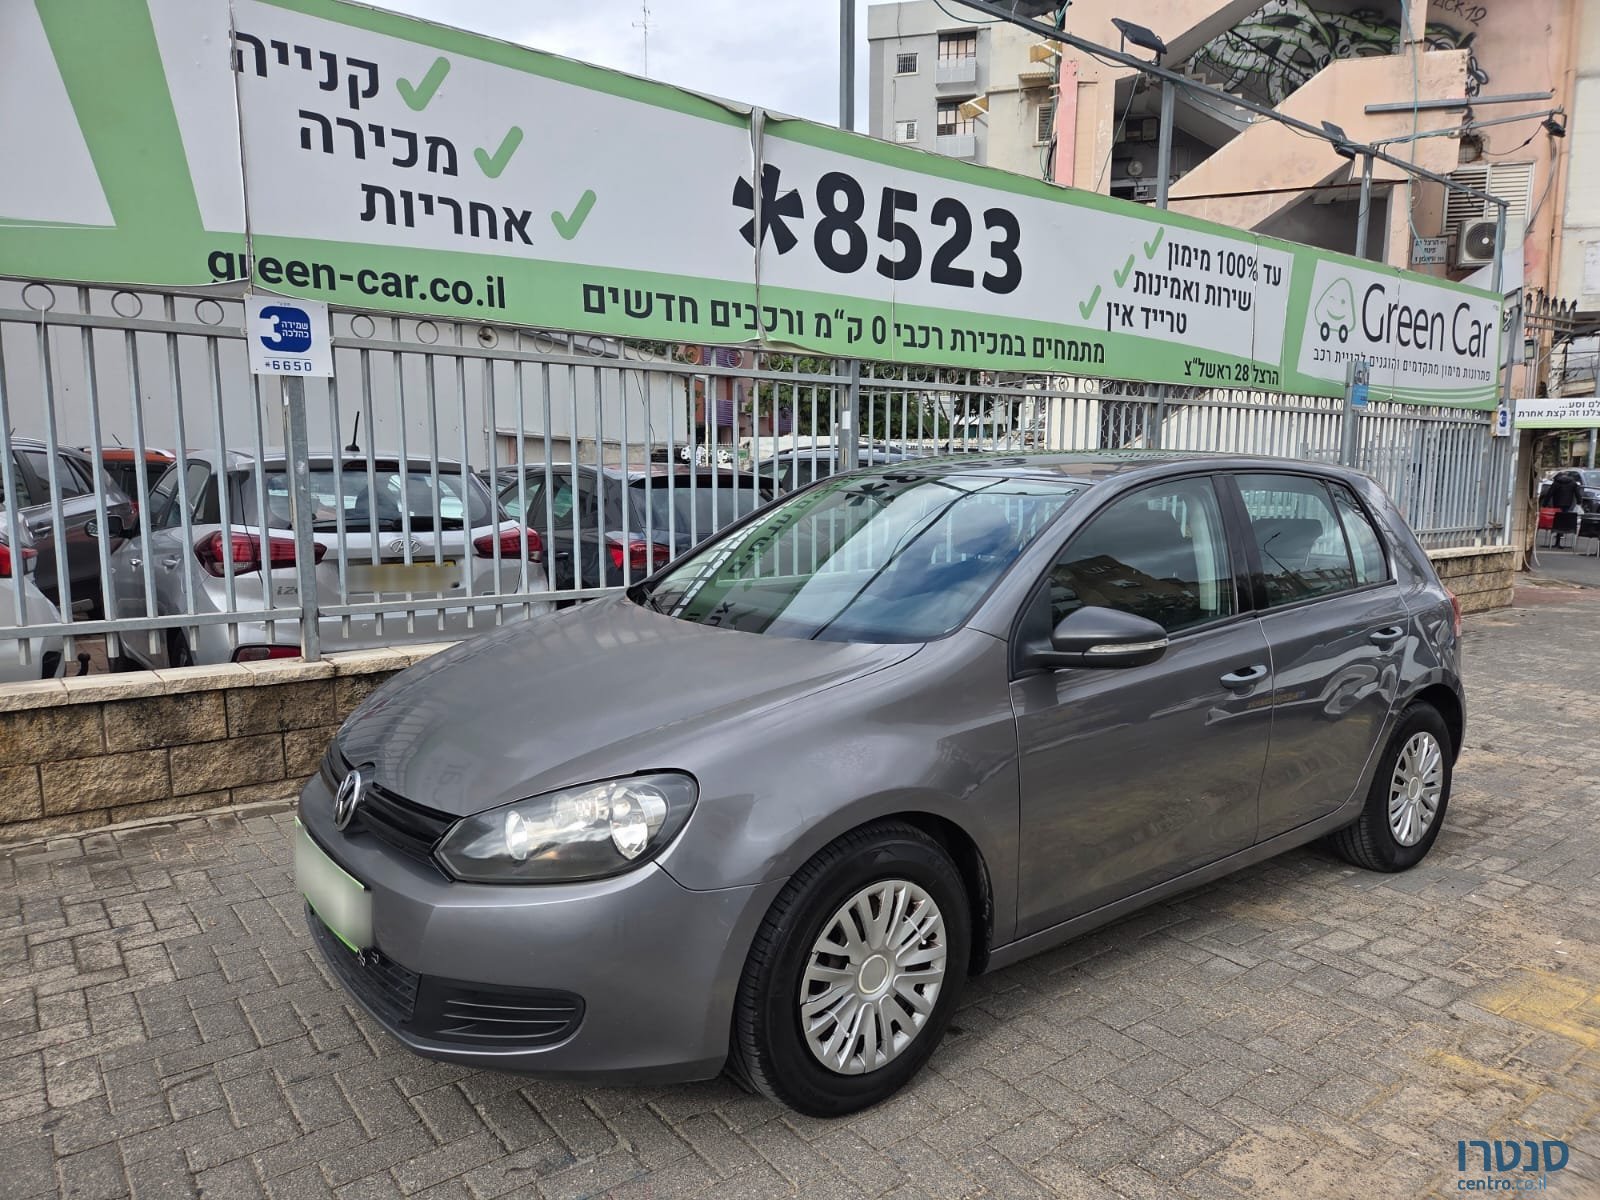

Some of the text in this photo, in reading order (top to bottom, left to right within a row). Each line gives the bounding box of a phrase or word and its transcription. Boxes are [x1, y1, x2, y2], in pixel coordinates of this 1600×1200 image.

[234, 31, 380, 110] קנייה
[299, 109, 458, 176] מכירה
[360, 183, 534, 245] אחריות
[1168, 242, 1282, 286] עד 100% מימון
[207, 249, 505, 309] green-car.co.il
[1133, 270, 1252, 312] שירות ואמינות
[582, 283, 698, 324] חדשים
[281, 321, 309, 330] שמירה
[710, 300, 803, 336] ורכבים
[1106, 302, 1187, 334] טרייד אין
[1362, 283, 1493, 358] Green Car
[282, 329, 310, 338] כהלכה
[893, 322, 943, 350] רכבי
[950, 331, 1025, 358] במכירת
[1031, 338, 1105, 363] מתמחים
[1313, 347, 1331, 362] רכב
[1235, 363, 1249, 382] 28
[1252, 365, 1279, 385] הרצל
[1403, 360, 1438, 376] מתקדמים
[1441, 364, 1460, 379] מימון
[1462, 367, 1491, 381] פתרונות
[1546, 410, 1566, 419] קצת
